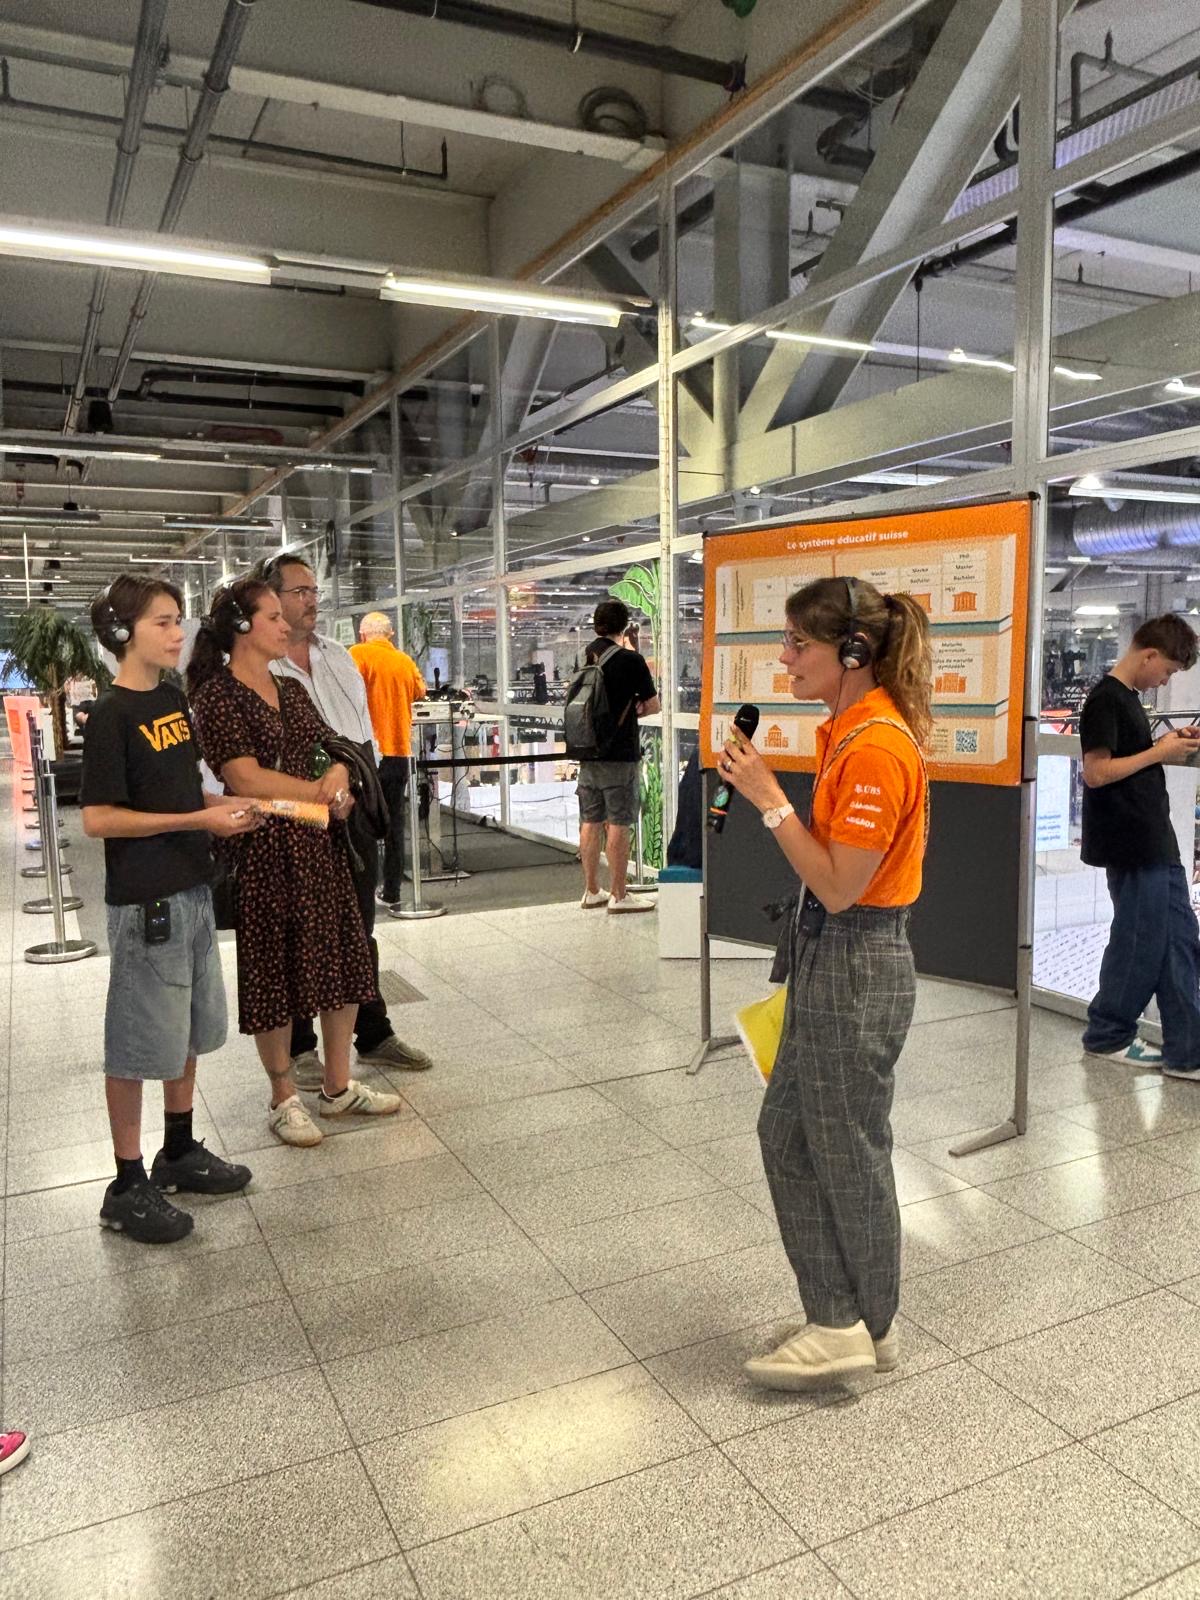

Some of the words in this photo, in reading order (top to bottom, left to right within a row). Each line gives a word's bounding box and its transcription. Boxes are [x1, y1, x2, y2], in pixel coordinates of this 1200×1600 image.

[787, 541, 797, 550] Le
[799, 537, 835, 550] système
[837, 532, 877, 545] éducatif
[879, 530, 909, 541] suisse
[138, 711, 191, 752] VANS
